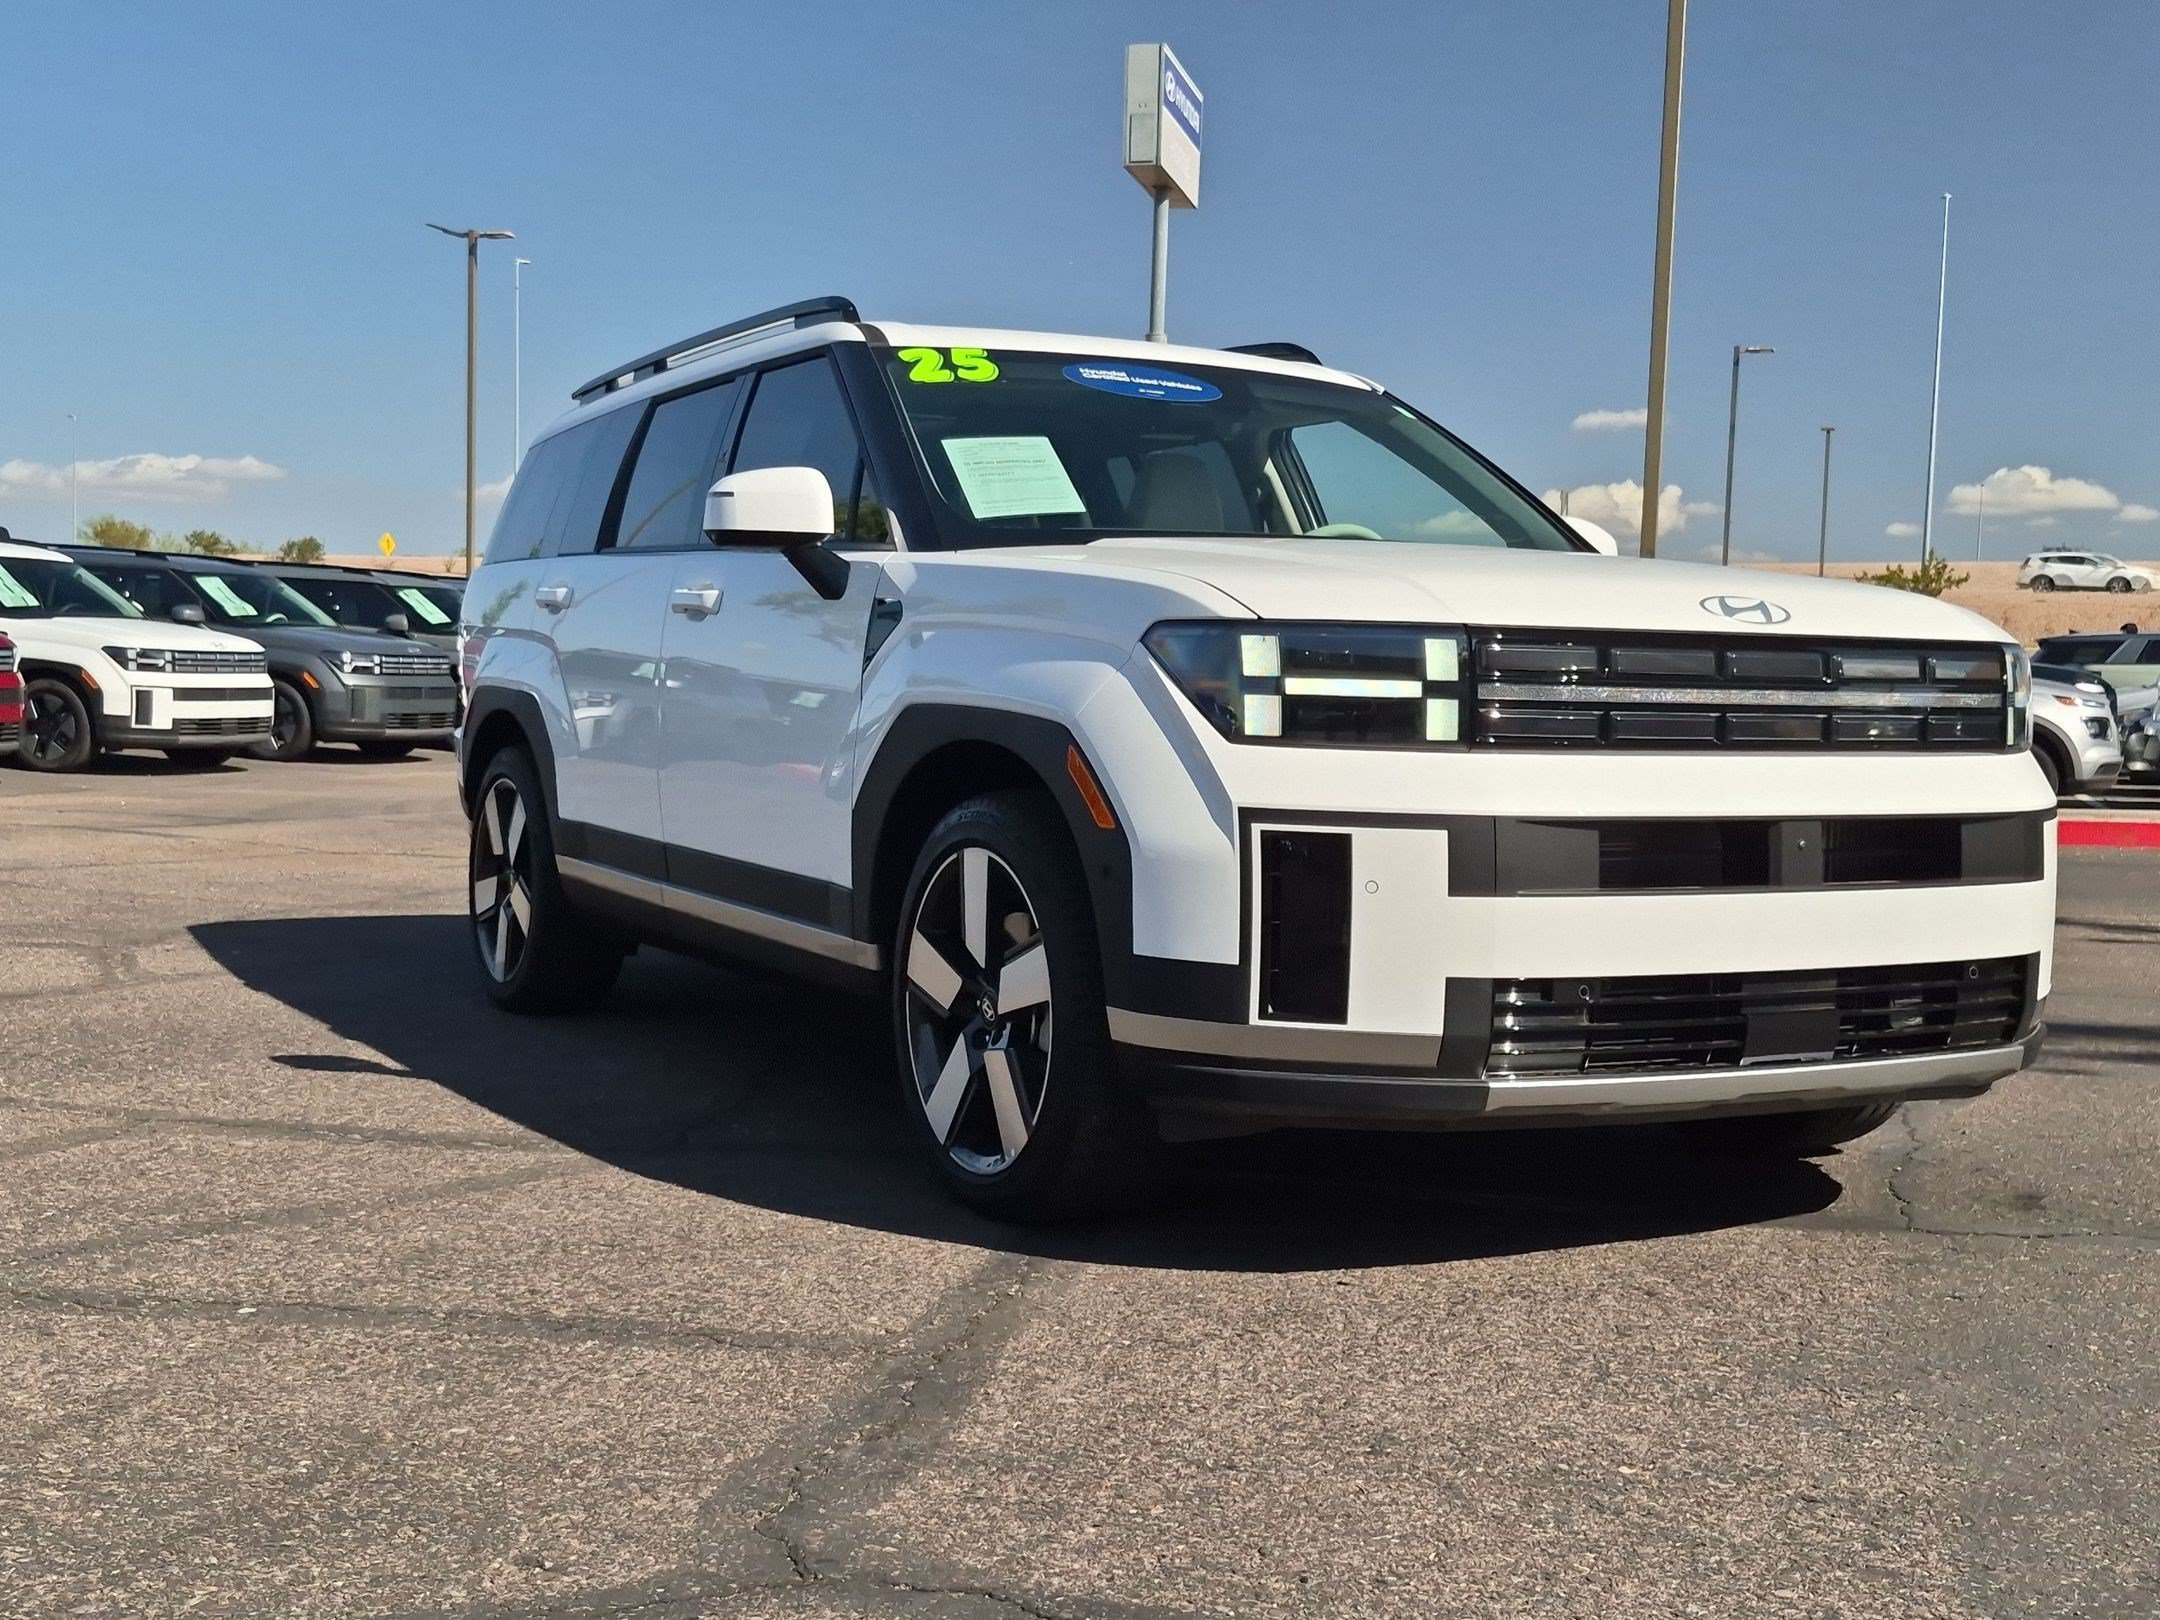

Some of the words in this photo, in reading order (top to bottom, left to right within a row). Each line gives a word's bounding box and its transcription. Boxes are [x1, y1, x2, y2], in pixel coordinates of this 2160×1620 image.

[897, 347, 999, 383] 25
[1079, 367, 1127, 377] Hyundai
[1131, 377, 1158, 385] Used
[1159, 381, 1203, 391] Vehicles
